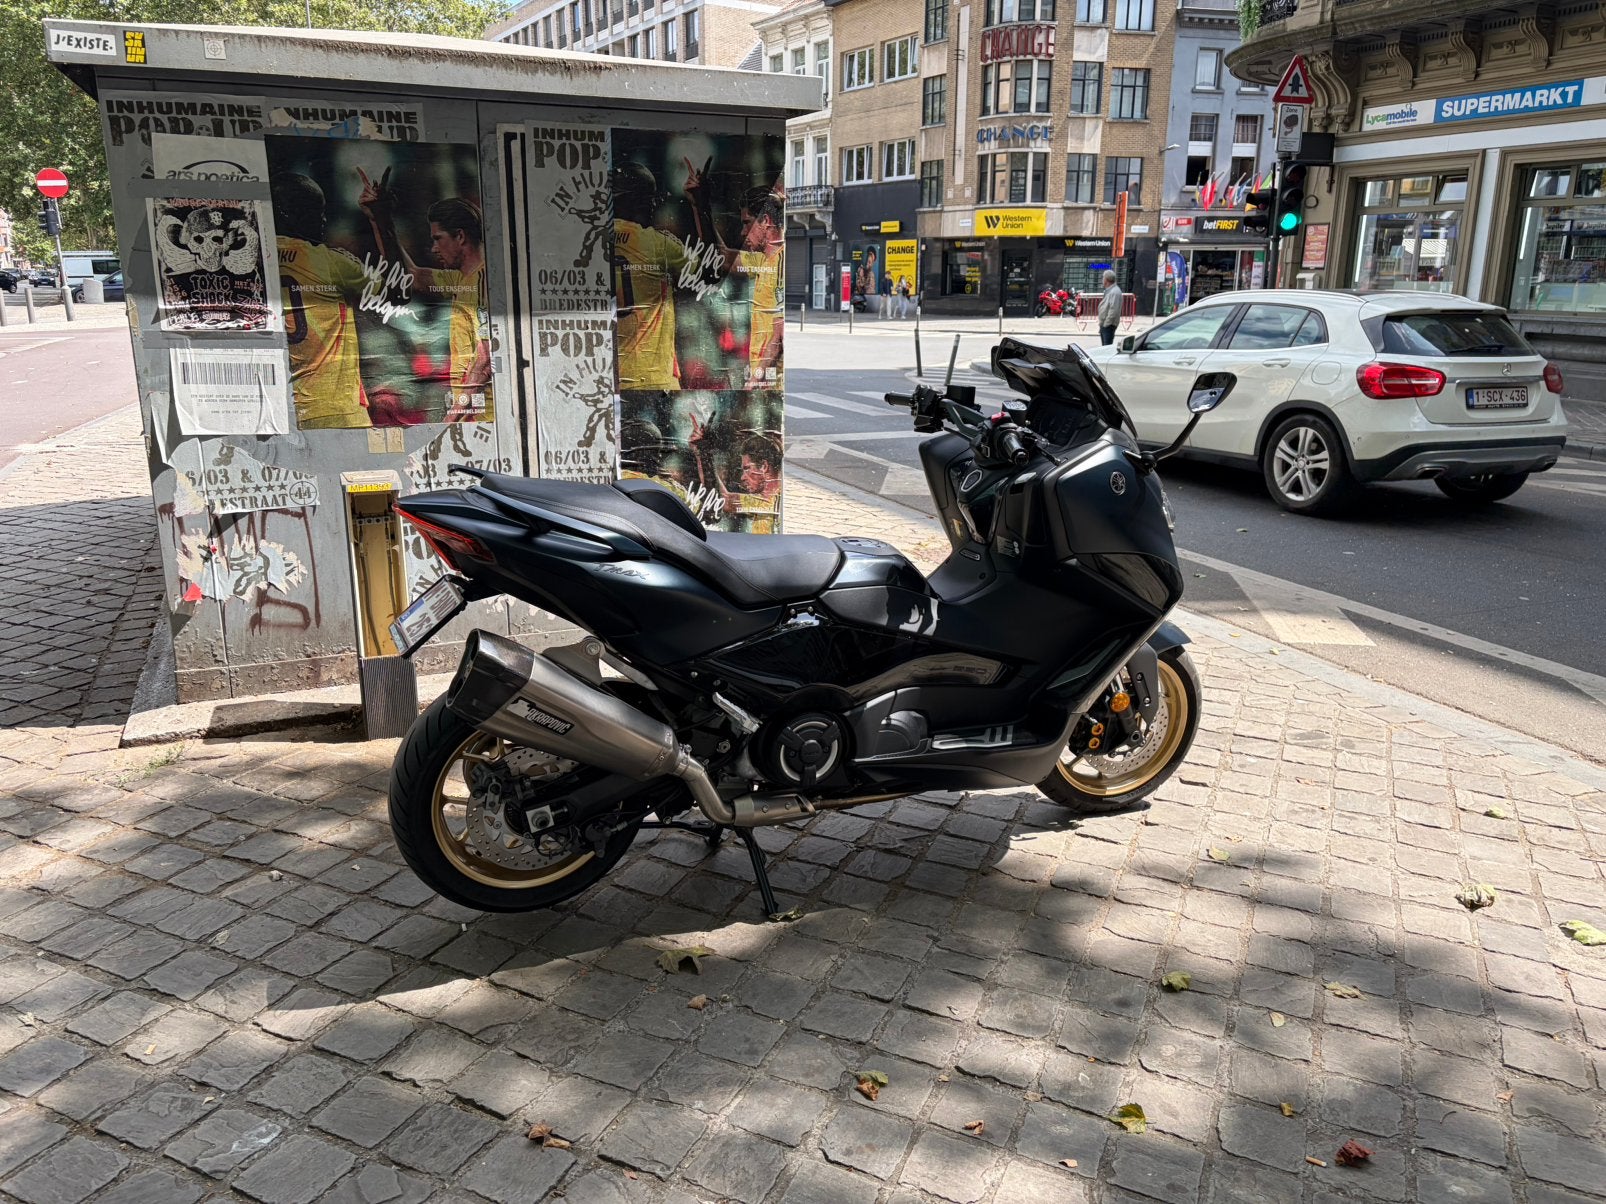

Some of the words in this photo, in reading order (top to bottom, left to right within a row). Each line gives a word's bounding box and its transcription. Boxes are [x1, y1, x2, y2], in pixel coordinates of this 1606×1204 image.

[980, 24, 1056, 63] CHANGE
[106, 100, 262, 118] INHUMAINE
[1441, 85, 1579, 118] SUPERMARKT
[1366, 109, 1418, 125] Lycamobile
[976, 124, 1054, 144] CHANGE
[533, 140, 602, 170] POP
[1002, 214, 1033, 223] Western
[1002, 221, 1024, 229] Union
[1203, 219, 1240, 230] betFIRST
[887, 245, 915, 255] CHANGE
[1075, 239, 1095, 247] Western
[1096, 239, 1111, 247] Union
[189, 274, 231, 291] TOXIC
[538, 268, 587, 286] 06/03
[291, 284, 314, 292] SAMEN
[316, 284, 338, 292] STERK
[428, 285, 444, 293] TOUS
[445, 285, 478, 293] ENSEMBLE
[190, 289, 235, 306] SHOCK
[538, 331, 604, 358] POP
[543, 450, 590, 466] 06/03
